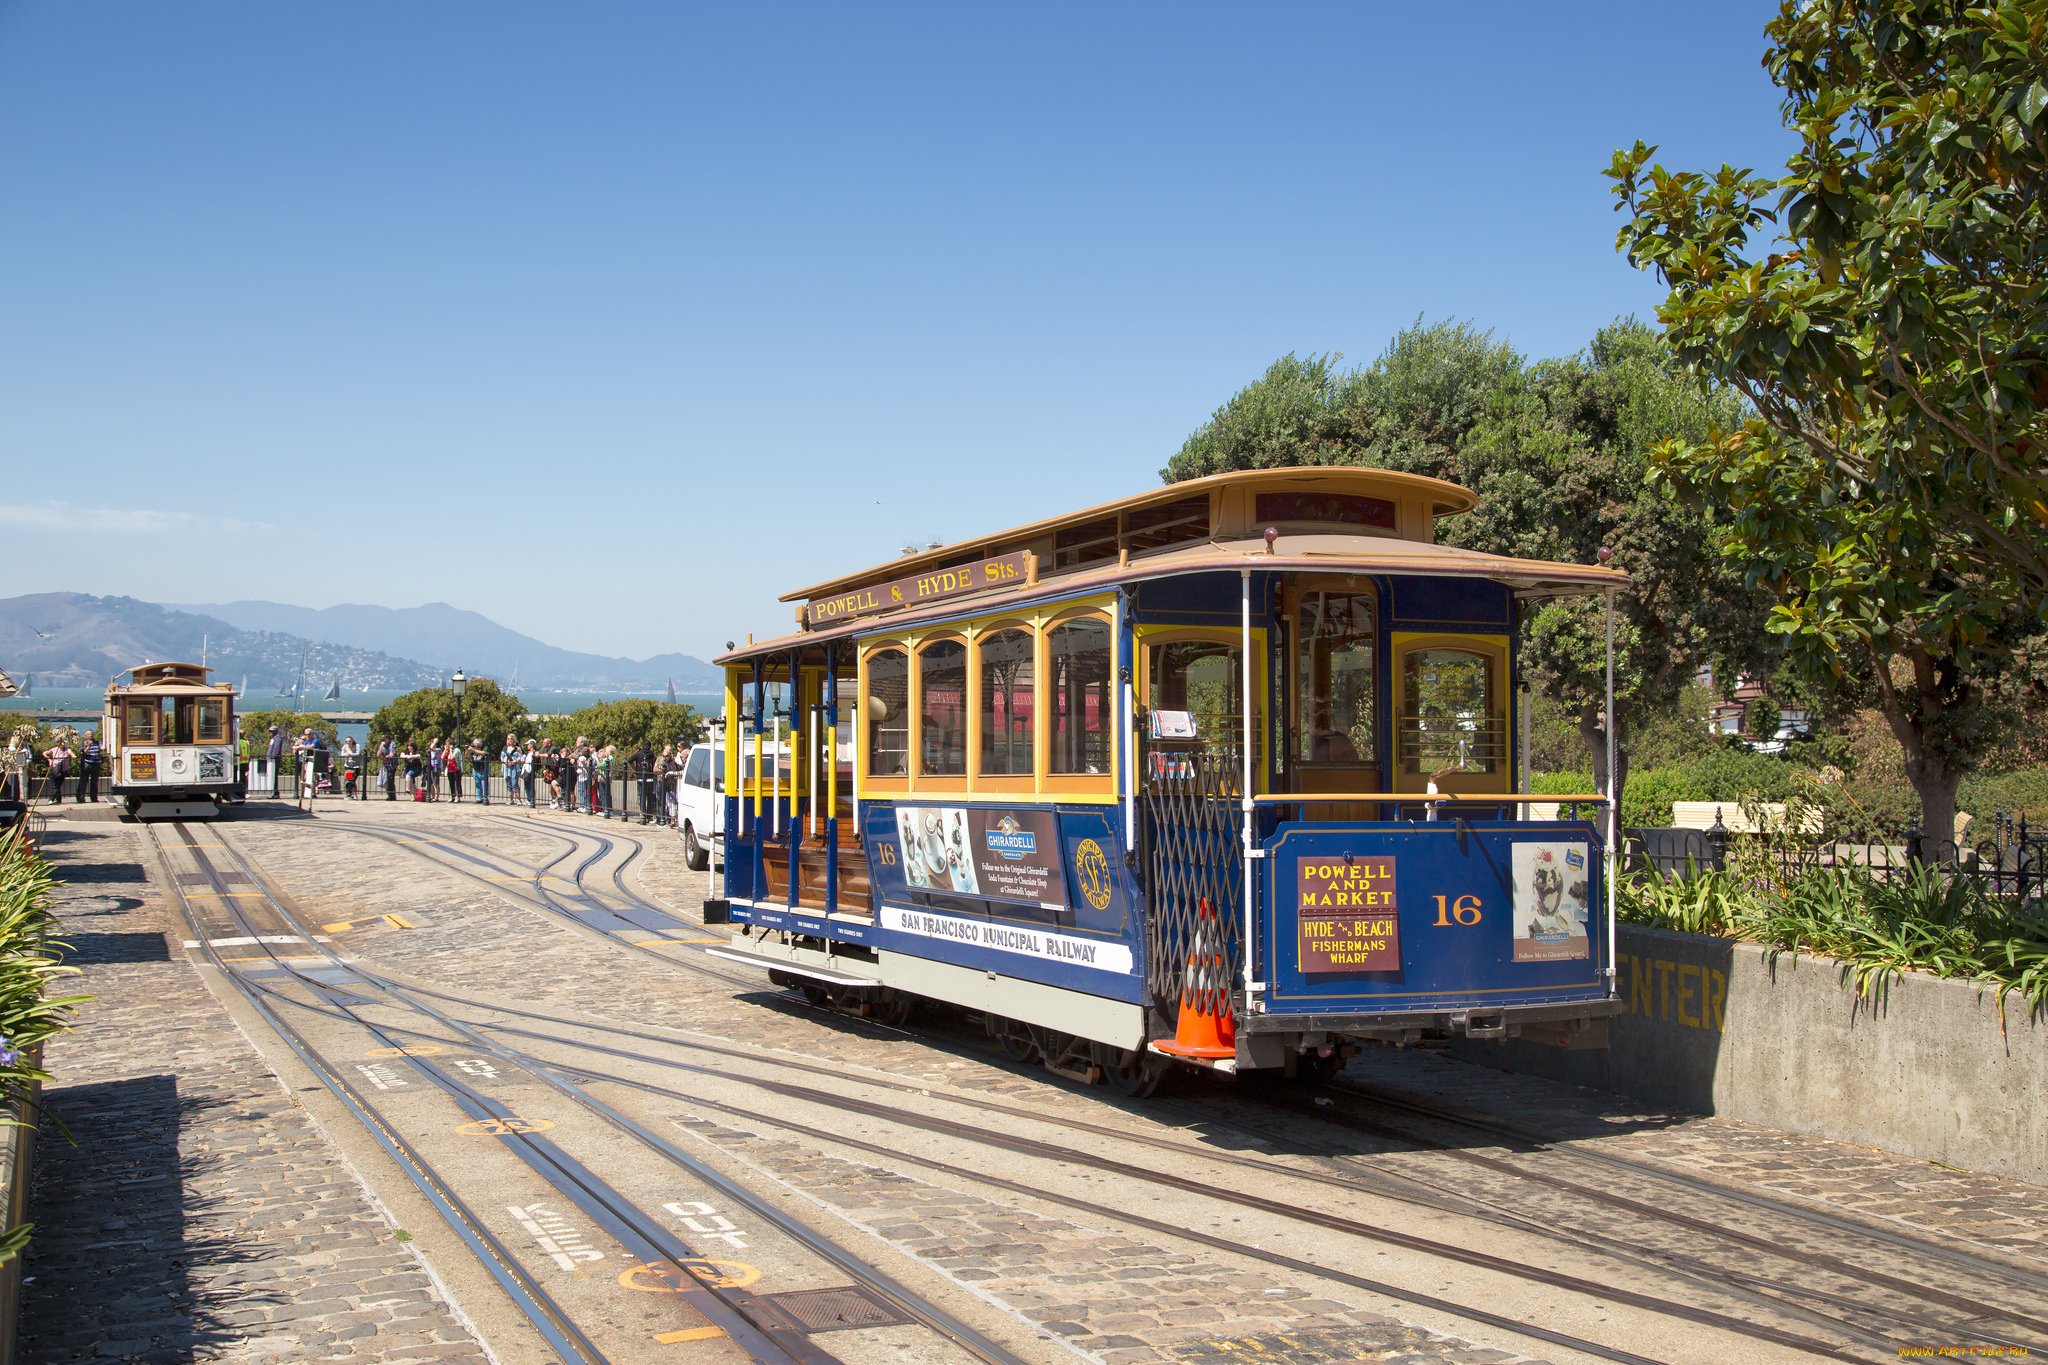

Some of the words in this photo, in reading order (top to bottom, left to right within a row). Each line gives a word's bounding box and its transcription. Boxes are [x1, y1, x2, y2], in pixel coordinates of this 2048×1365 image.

[816, 591, 879, 619] POWELL
[891, 585, 903, 602] &
[917, 569, 973, 597] HYDE
[984, 562, 1019, 583] Sts.
[171, 749, 186, 757] 17
[988, 835, 1035, 849] GHIRARDELLI
[876, 842, 896, 866] 16
[1076, 840, 1106, 872] MUNICIPAL
[981, 862, 994, 871] Follow
[1010, 865, 1027, 876] Original
[1304, 865, 1391, 880] POWELL
[988, 874, 998, 882] Soda
[997, 874, 1014, 884] Fountain
[1018, 876, 1037, 886] Chocolate
[1037, 878, 1048, 889] Shop
[1327, 880, 1371, 891] AND
[1004, 885, 1025, 895] Ghirardelli
[1082, 883, 1111, 908] RAILWAY
[1302, 891, 1393, 906] MARKET
[1431, 894, 1483, 926] 16
[1304, 921, 1336, 938] HYDE
[1337, 922, 1353, 937] AND
[1354, 919, 1394, 937] BEACH
[901, 913, 921, 931] SAN
[923, 916, 978, 941] FRANCISCO
[983, 930, 1041, 953] MUNICIPAL
[1046, 938, 1096, 964] RAILWAY
[1312, 940, 1387, 953] FISHERMANS
[1330, 952, 1369, 964] WHARF
